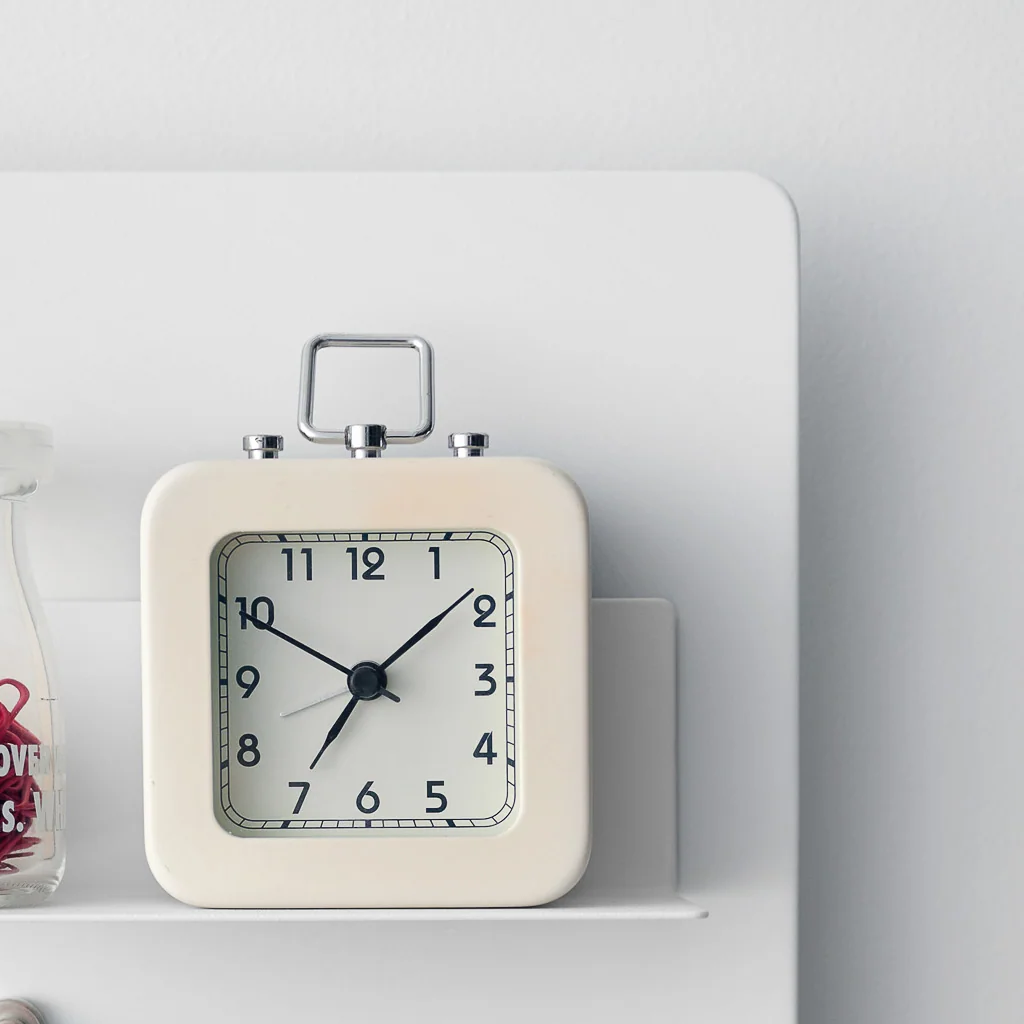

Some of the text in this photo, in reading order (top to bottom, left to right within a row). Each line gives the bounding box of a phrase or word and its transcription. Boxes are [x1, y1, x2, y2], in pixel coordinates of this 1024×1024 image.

[280, 547, 313, 581] 11
[345, 547, 386, 581] 12
[427, 546, 441, 580] 1
[234, 596, 275, 630] 10
[473, 594, 497, 628] 2
[235, 665, 261, 699] 9
[474, 664, 497, 697] 3
[236, 733, 261, 768] 8
[472, 731, 498, 766] 4
[288, 781, 311, 815] 7
[355, 780, 381, 815] 6
[425, 780, 448, 814] 5
